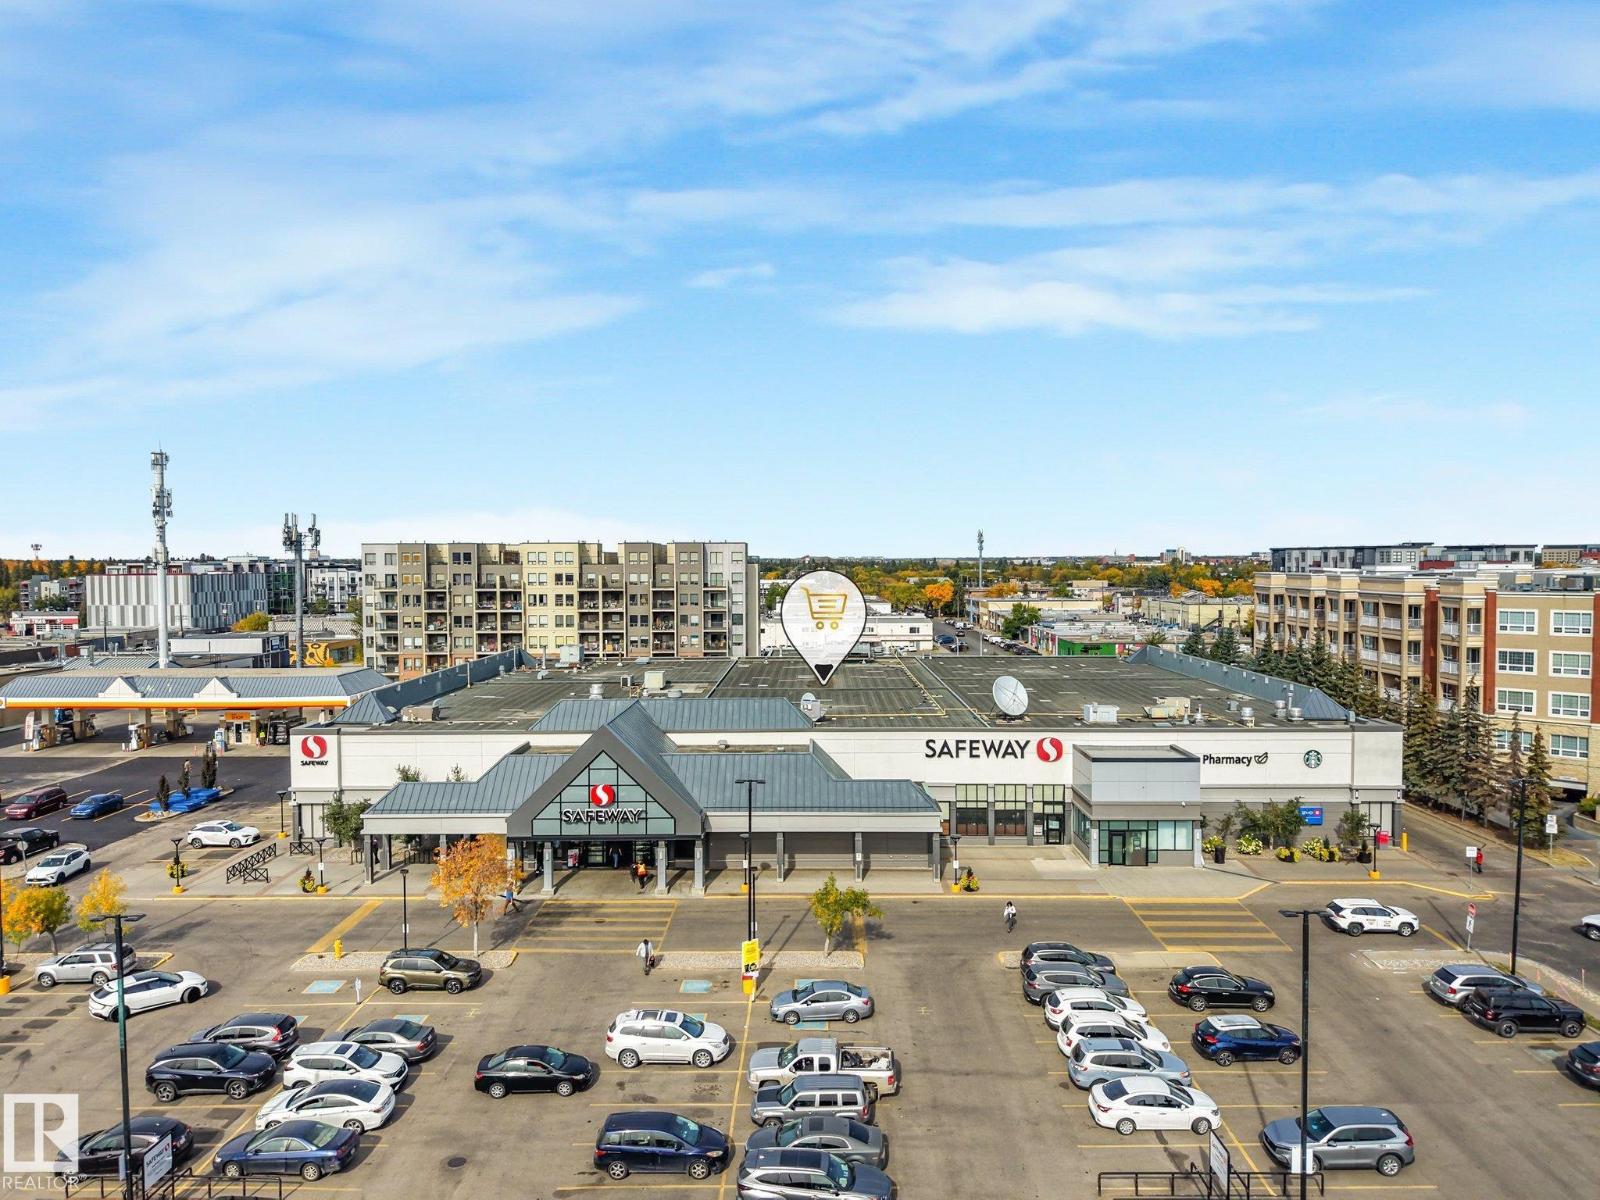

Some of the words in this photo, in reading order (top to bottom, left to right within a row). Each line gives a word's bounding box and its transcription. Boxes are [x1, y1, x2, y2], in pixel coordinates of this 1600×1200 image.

[924, 738, 1031, 759] SAFEWAY
[1202, 753, 1253, 767] Pharmacy
[561, 807, 644, 824] SAFEWAY
